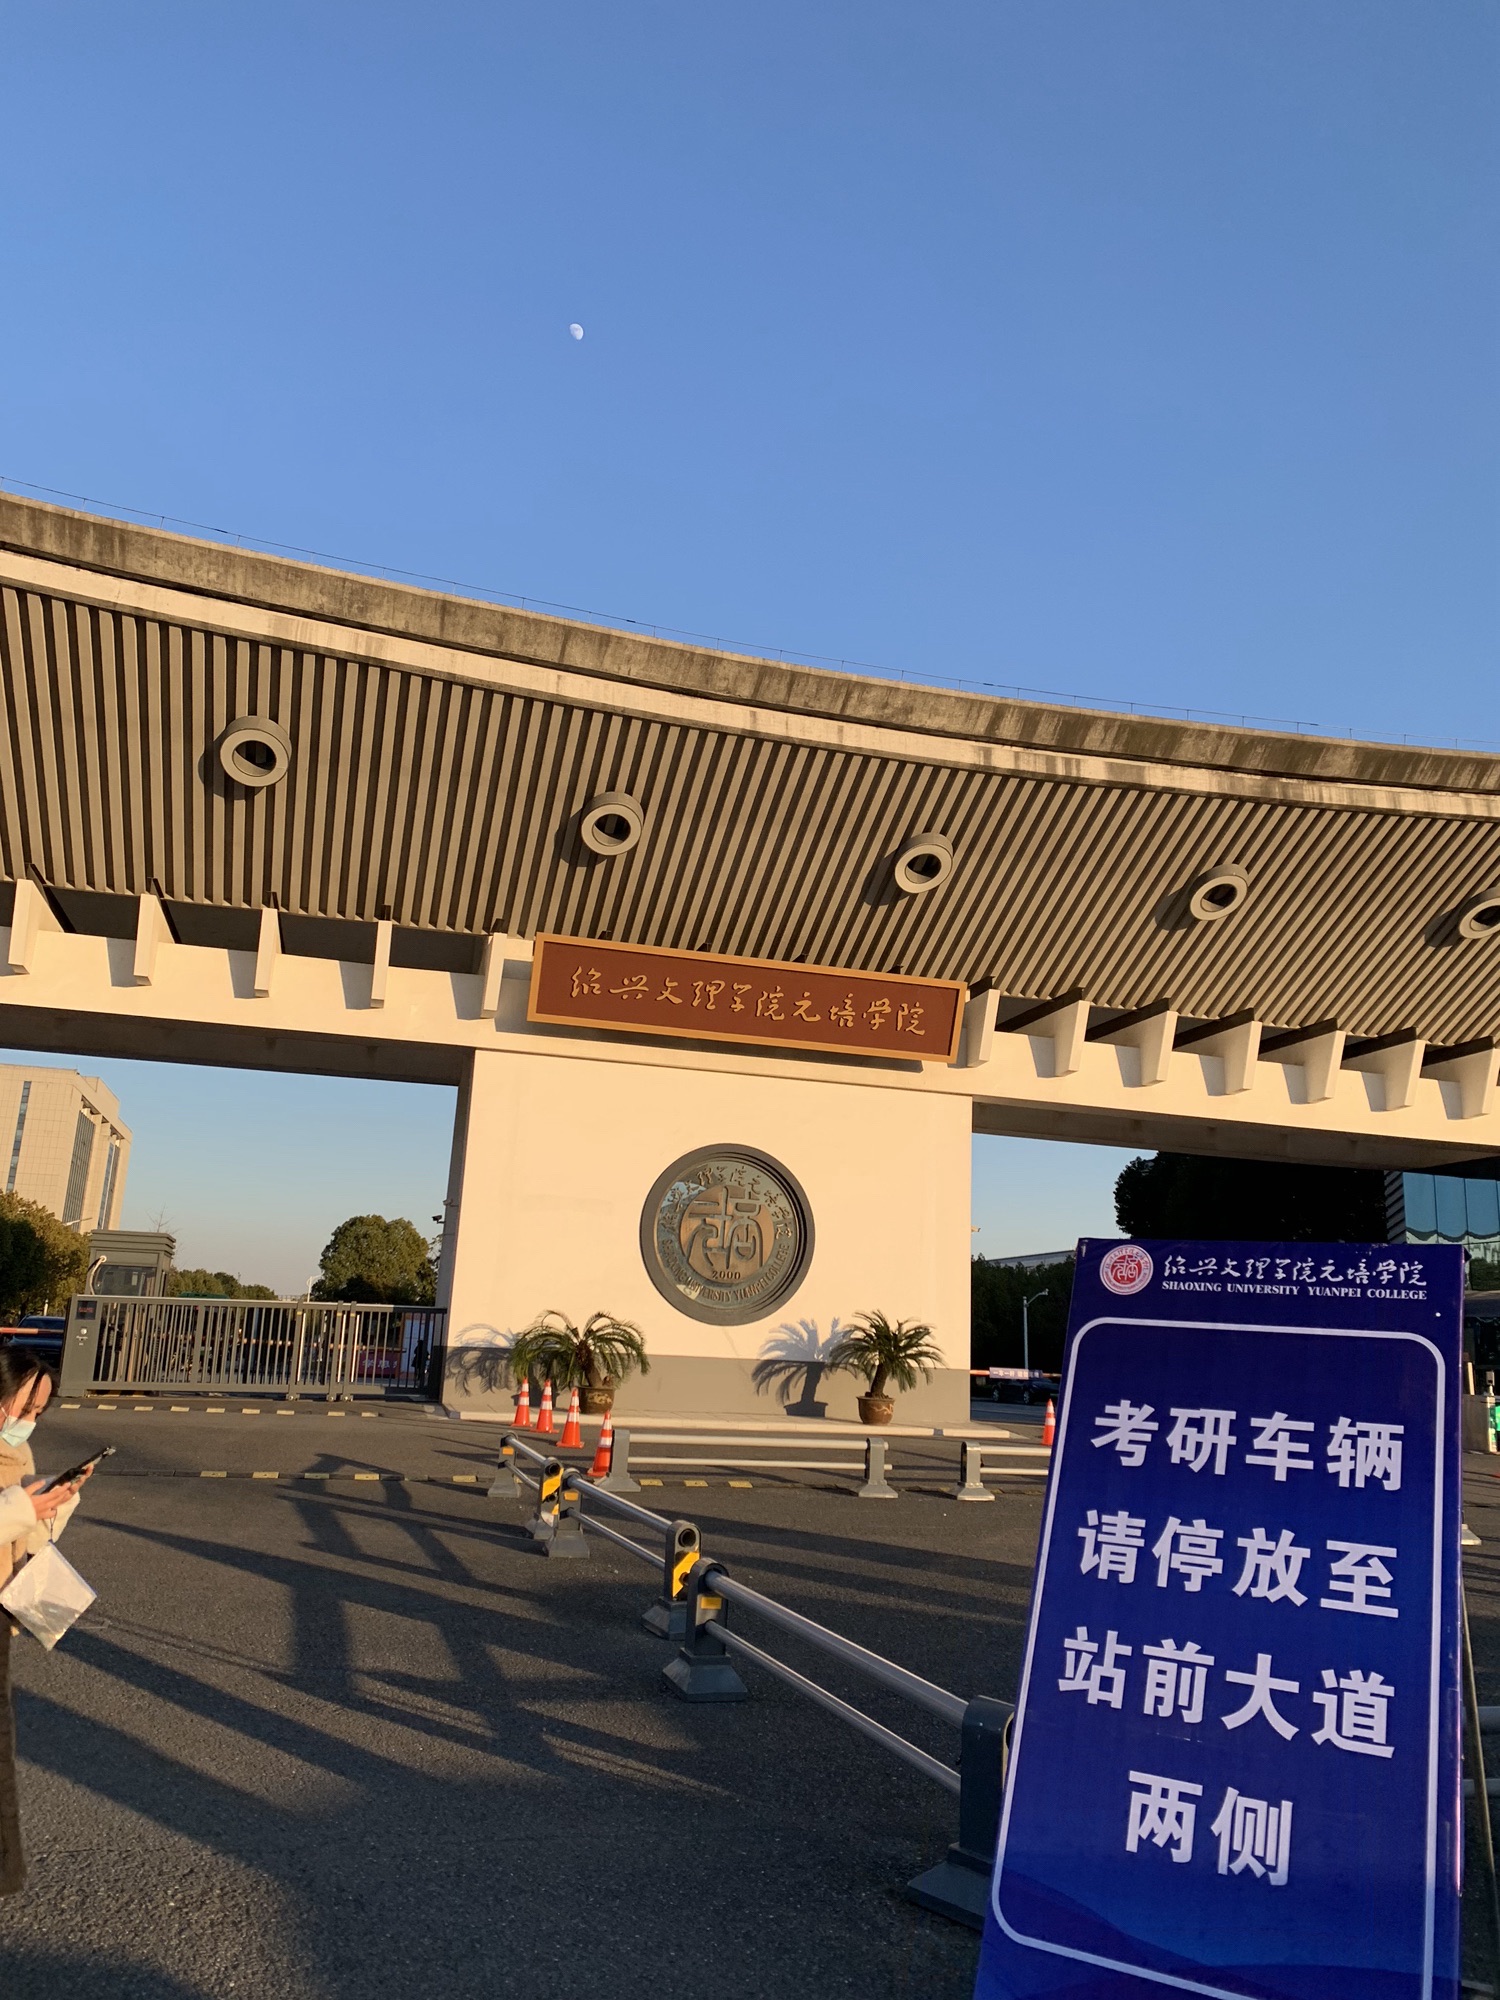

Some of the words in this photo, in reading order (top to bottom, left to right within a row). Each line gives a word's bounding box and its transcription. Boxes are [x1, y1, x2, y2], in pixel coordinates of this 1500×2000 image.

[569, 966, 926, 1036] 绍兴文理学院元培学院
[711, 1270, 741, 1280] 2000
[1162, 1280, 1222, 1293] SHAOXING
[1226, 1283, 1301, 1296] UNIVERSITY
[1308, 1287, 1362, 1299] YUANPEI
[1367, 1288, 1427, 1300] COLLEGE
[1163, 1254, 1428, 1287] 绍兴文理学院元培学院
[1091, 1399, 1405, 1491] 考研车辆
[1077, 1509, 1400, 1618] 请停放至
[1058, 1626, 1396, 1759] 站前大道
[1125, 1770, 1294, 1886] 两侧
